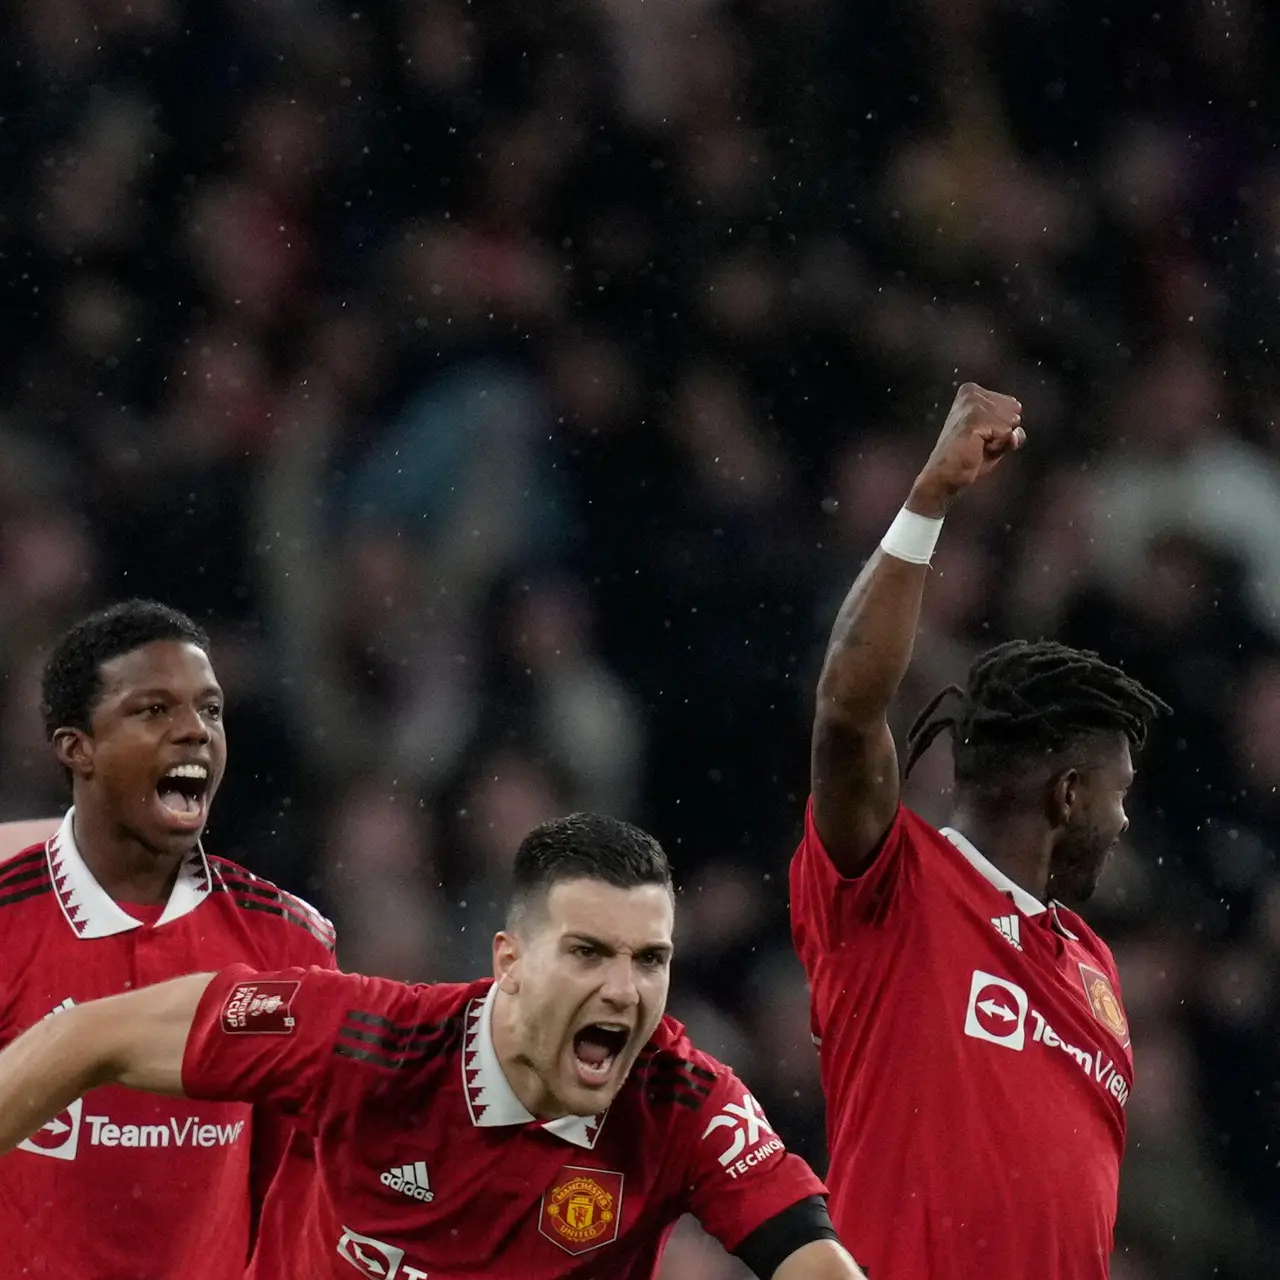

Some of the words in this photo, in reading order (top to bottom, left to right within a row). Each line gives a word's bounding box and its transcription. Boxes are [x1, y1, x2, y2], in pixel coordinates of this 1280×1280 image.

[226, 1001, 240, 1027] CUP
[380, 1171, 434, 1203] adidas
[556, 1182, 608, 1206] MANCHESTER
[560, 1225, 596, 1238] UNITED
